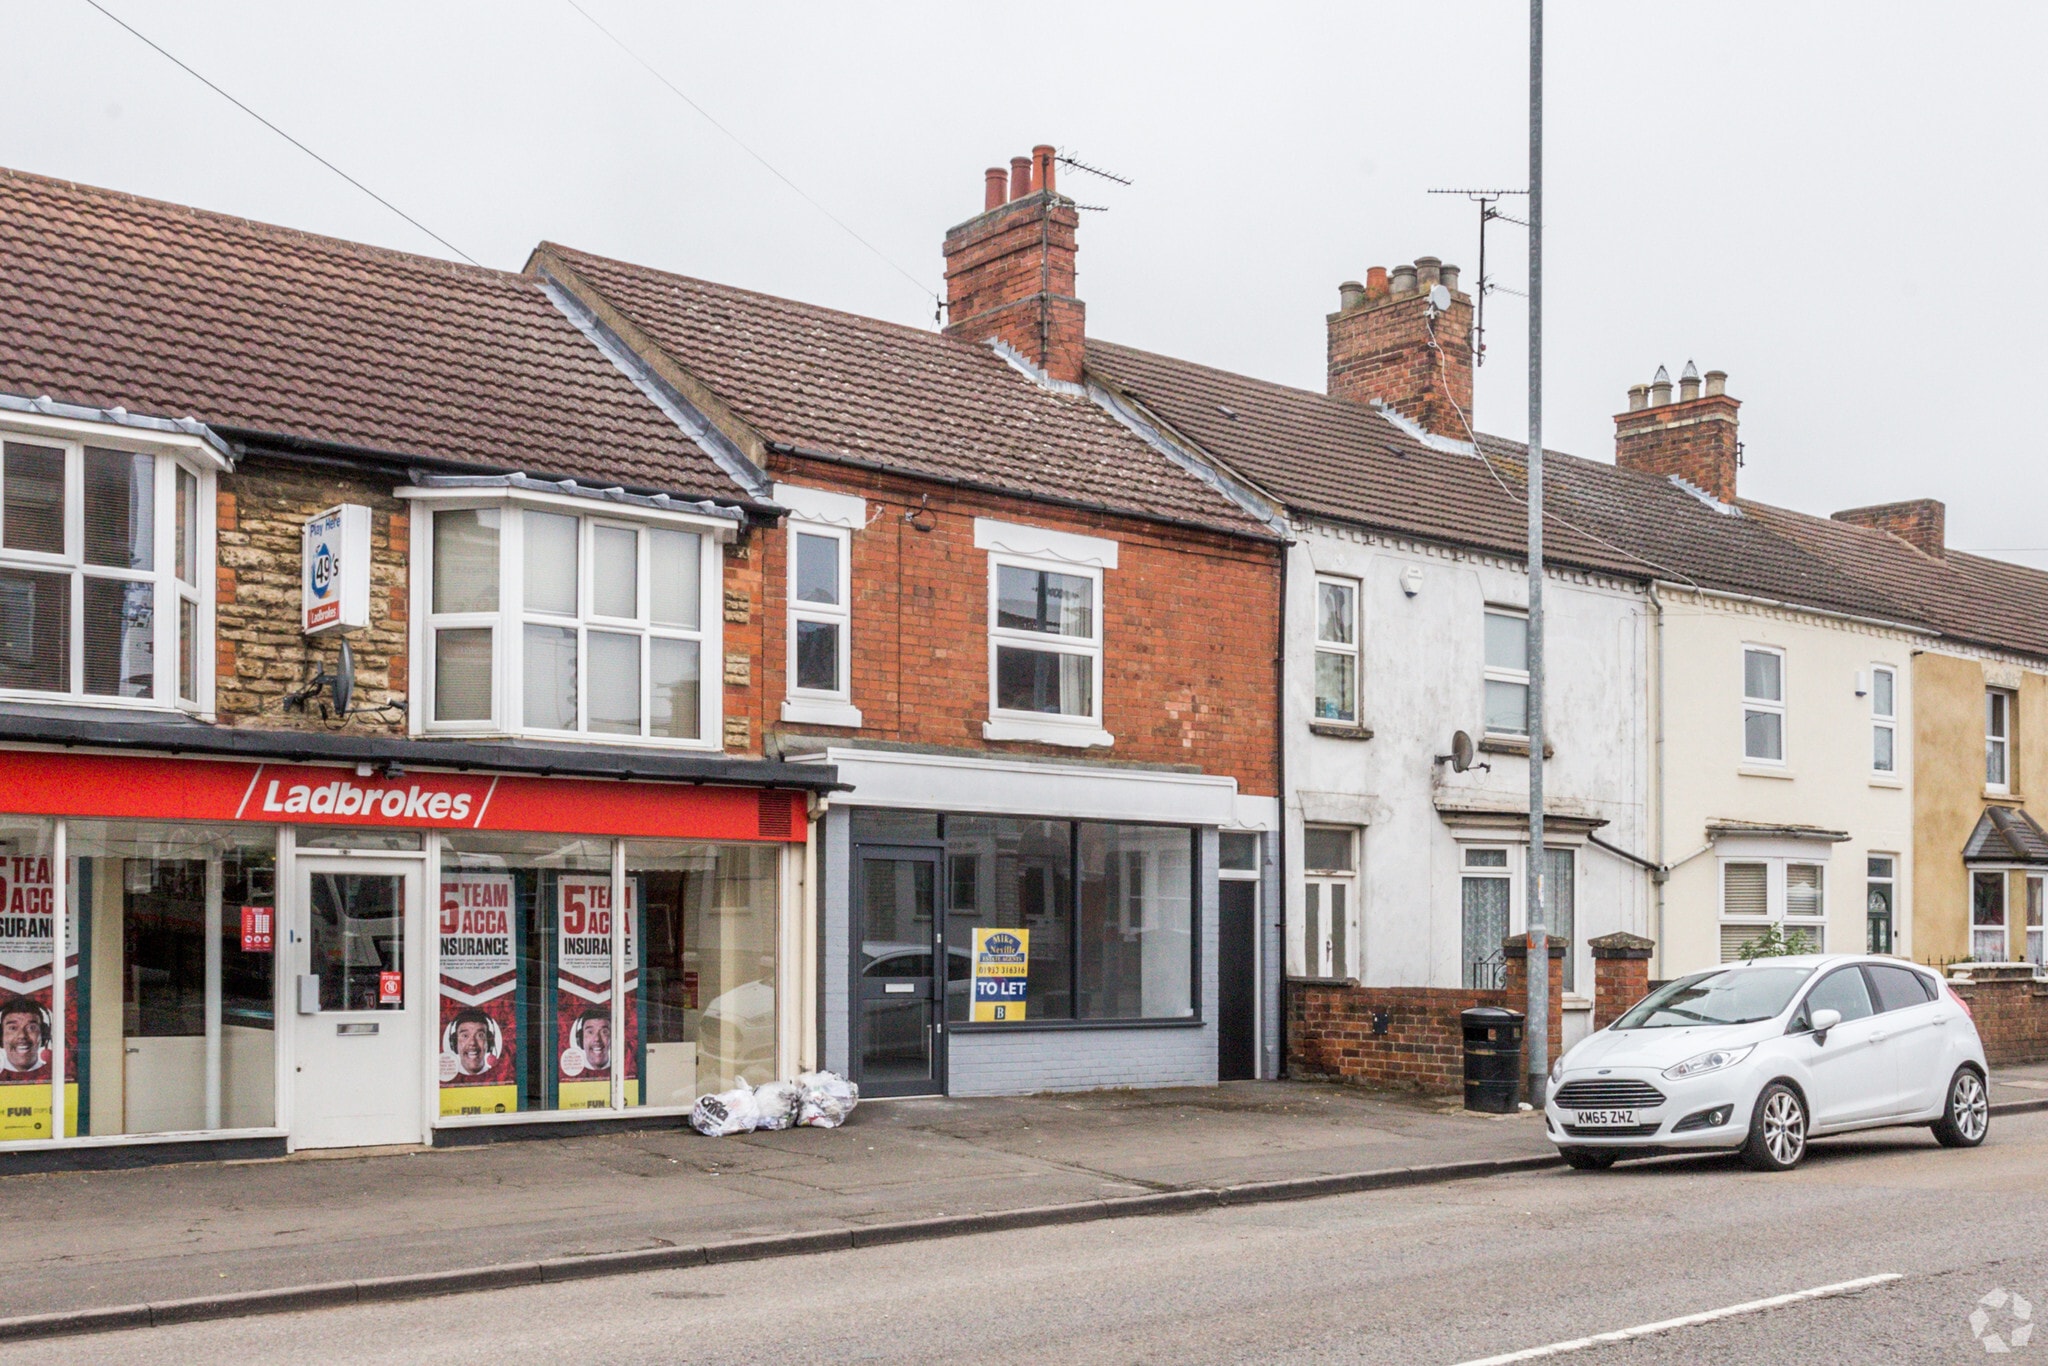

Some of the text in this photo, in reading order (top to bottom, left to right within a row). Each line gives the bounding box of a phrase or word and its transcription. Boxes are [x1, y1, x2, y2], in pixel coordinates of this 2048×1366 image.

[310, 517, 341, 537] Play Here
[316, 553, 339, 583] 49's
[311, 605, 337, 625] Ladbrokes
[263, 780, 472, 820] Ladbrokes
[440, 883, 508, 934] 5 TEAM
[564, 885, 585, 934] 5
[462, 910, 508, 934] ACCA
[440, 937, 508, 956] NSURANCE
[990, 945, 1016, 954] Neville
[993, 935, 1014, 945] Mike
[978, 982, 1026, 995] TO LET
[7, 1107, 32, 1117] FUN
[461, 1106, 481, 1115] FUN
[587, 1100, 605, 1108] FUN
[1578, 1111, 1634, 1124] KM65 ZHZ
